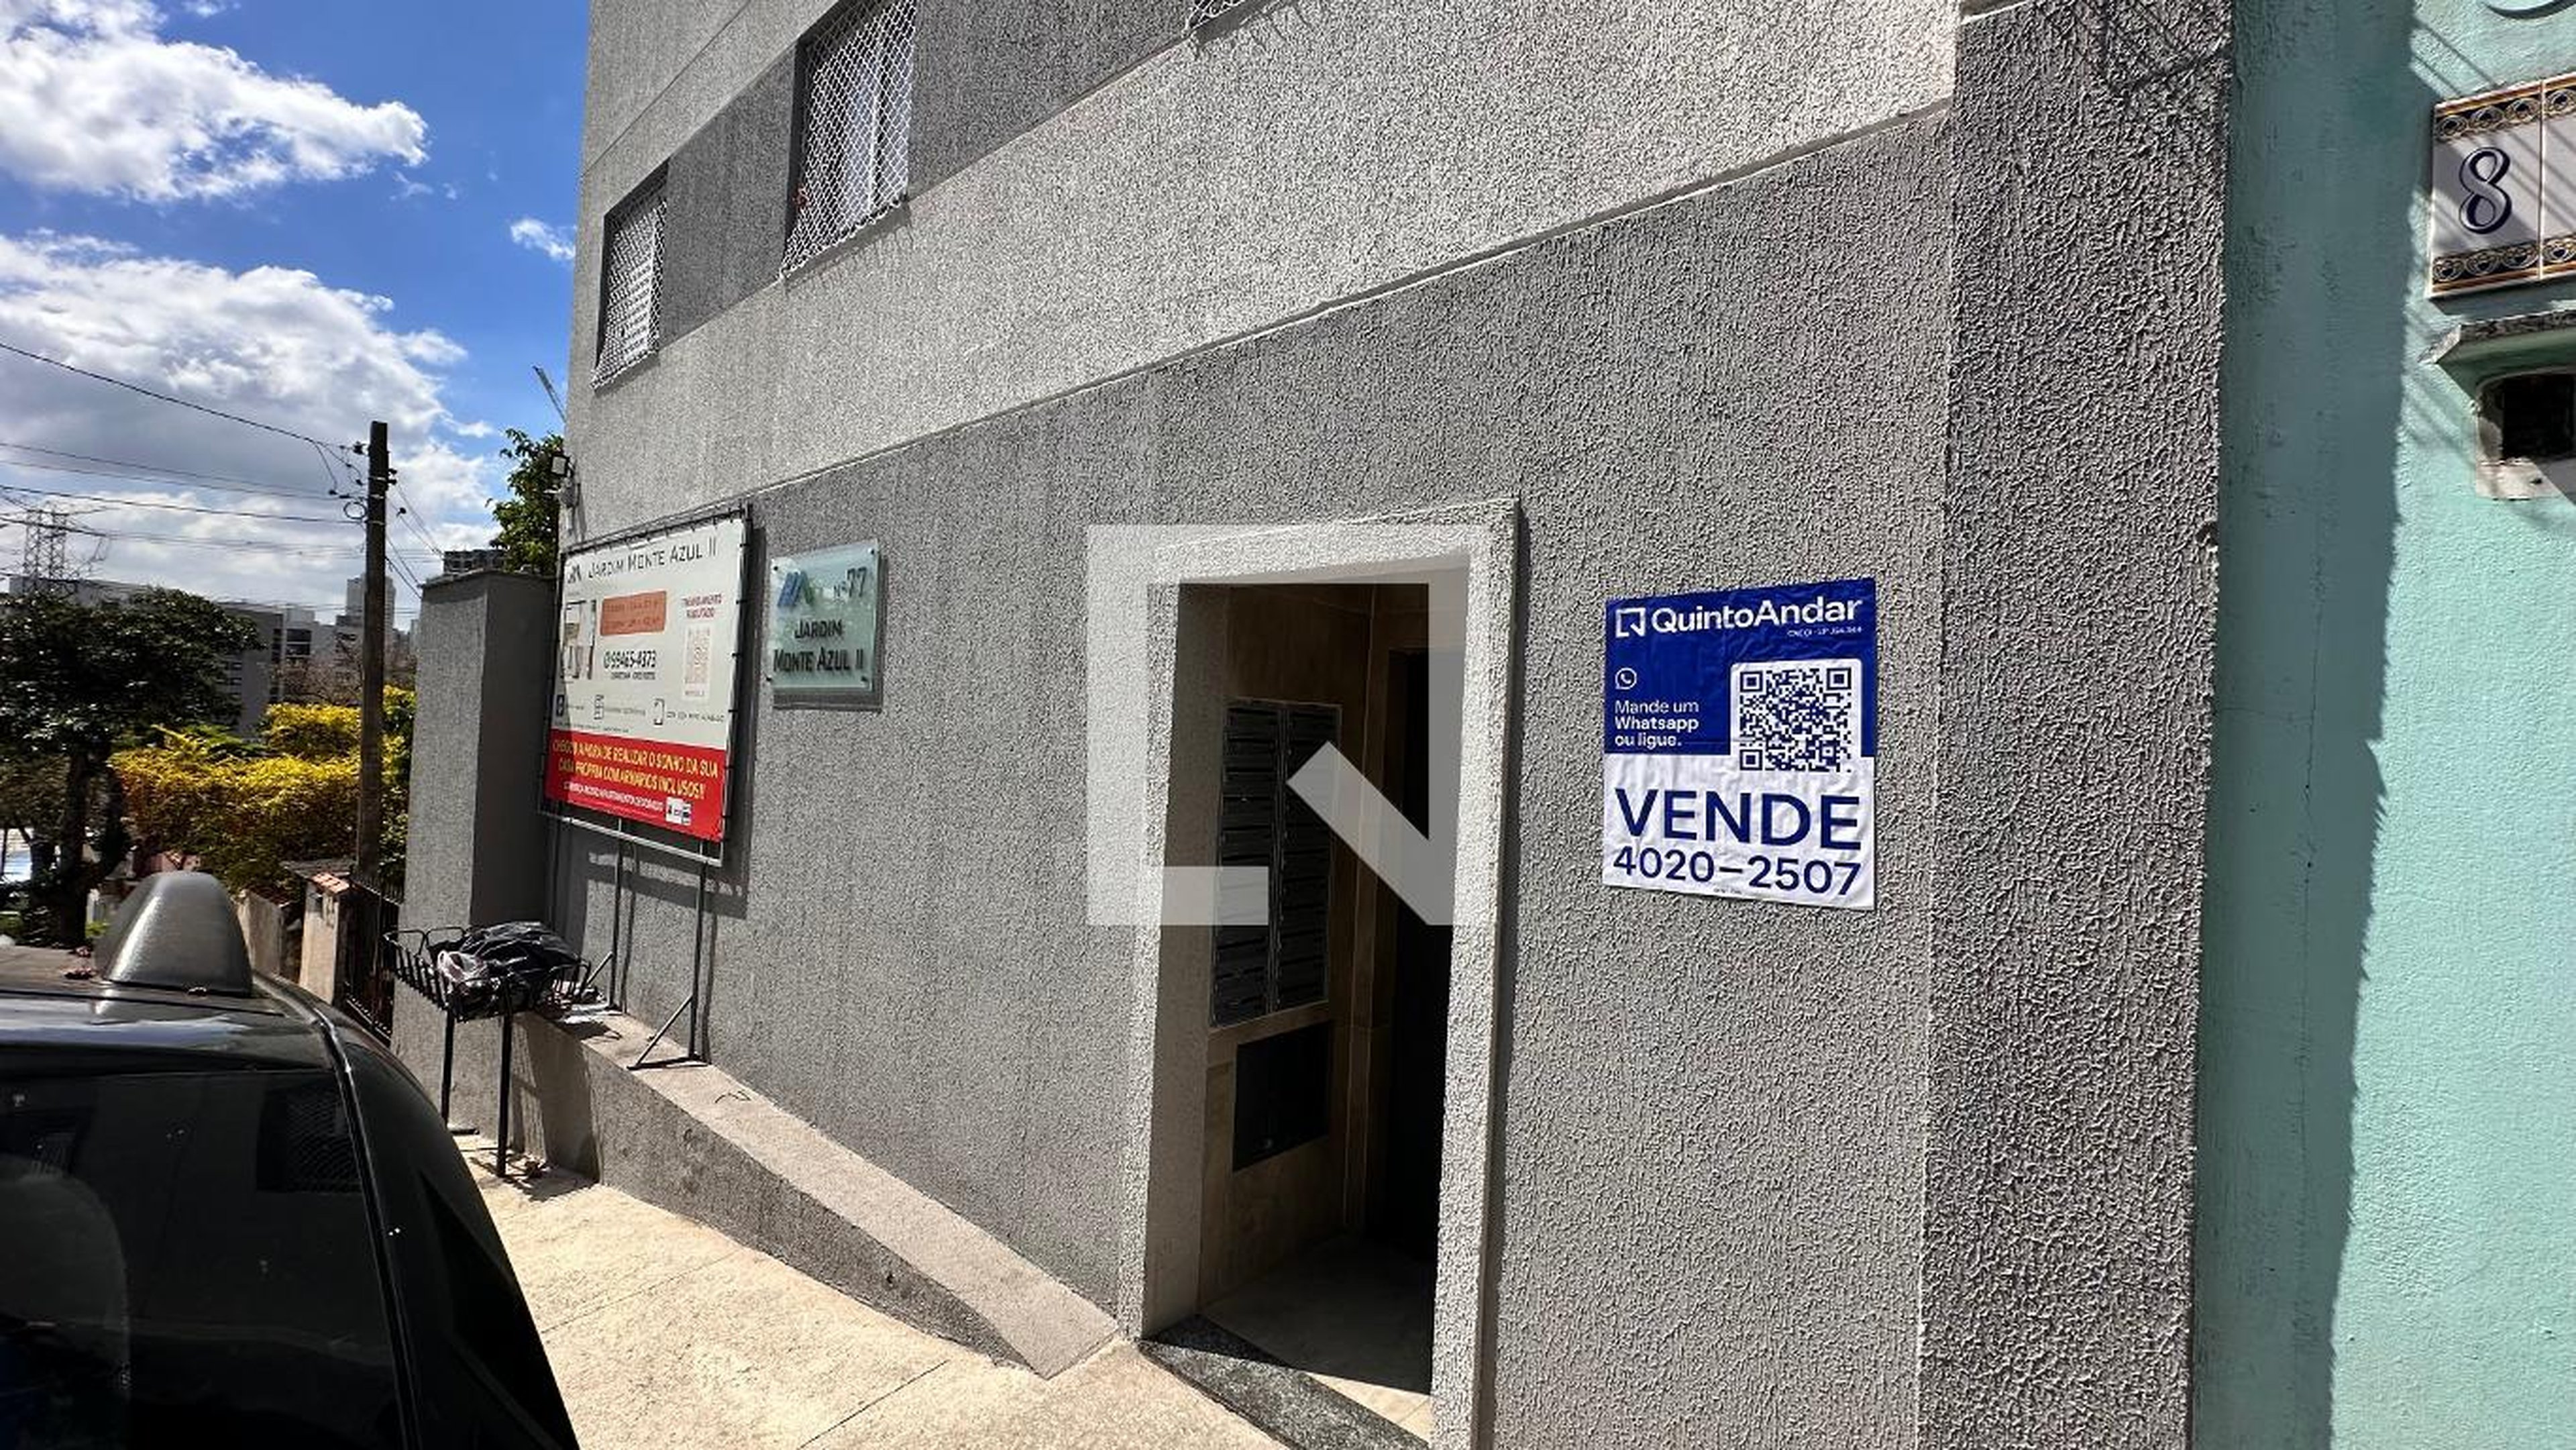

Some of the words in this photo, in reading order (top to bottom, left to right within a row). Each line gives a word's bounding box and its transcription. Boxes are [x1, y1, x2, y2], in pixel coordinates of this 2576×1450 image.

[2459, 146, 2512, 235] 8
[588, 559, 624, 578] JARDIM
[628, 550, 665, 571] MONTE
[671, 543, 703, 562] AZUL
[794, 619, 843, 639] JARDIM
[1652, 596, 1863, 633] QuintoAndar
[773, 648, 814, 672] MONTE
[817, 646, 851, 671] AZUL
[855, 648, 864, 670] II
[1615, 700, 1669, 714] Mande
[1673, 701, 1699, 713] um
[1615, 715, 1699, 733] Whatsapp
[1615, 735, 1635, 746] ou
[1637, 731, 1682, 750] ligue.
[1614, 788, 1862, 851] VENDE
[1613, 845, 1862, 896] 4020-2507
